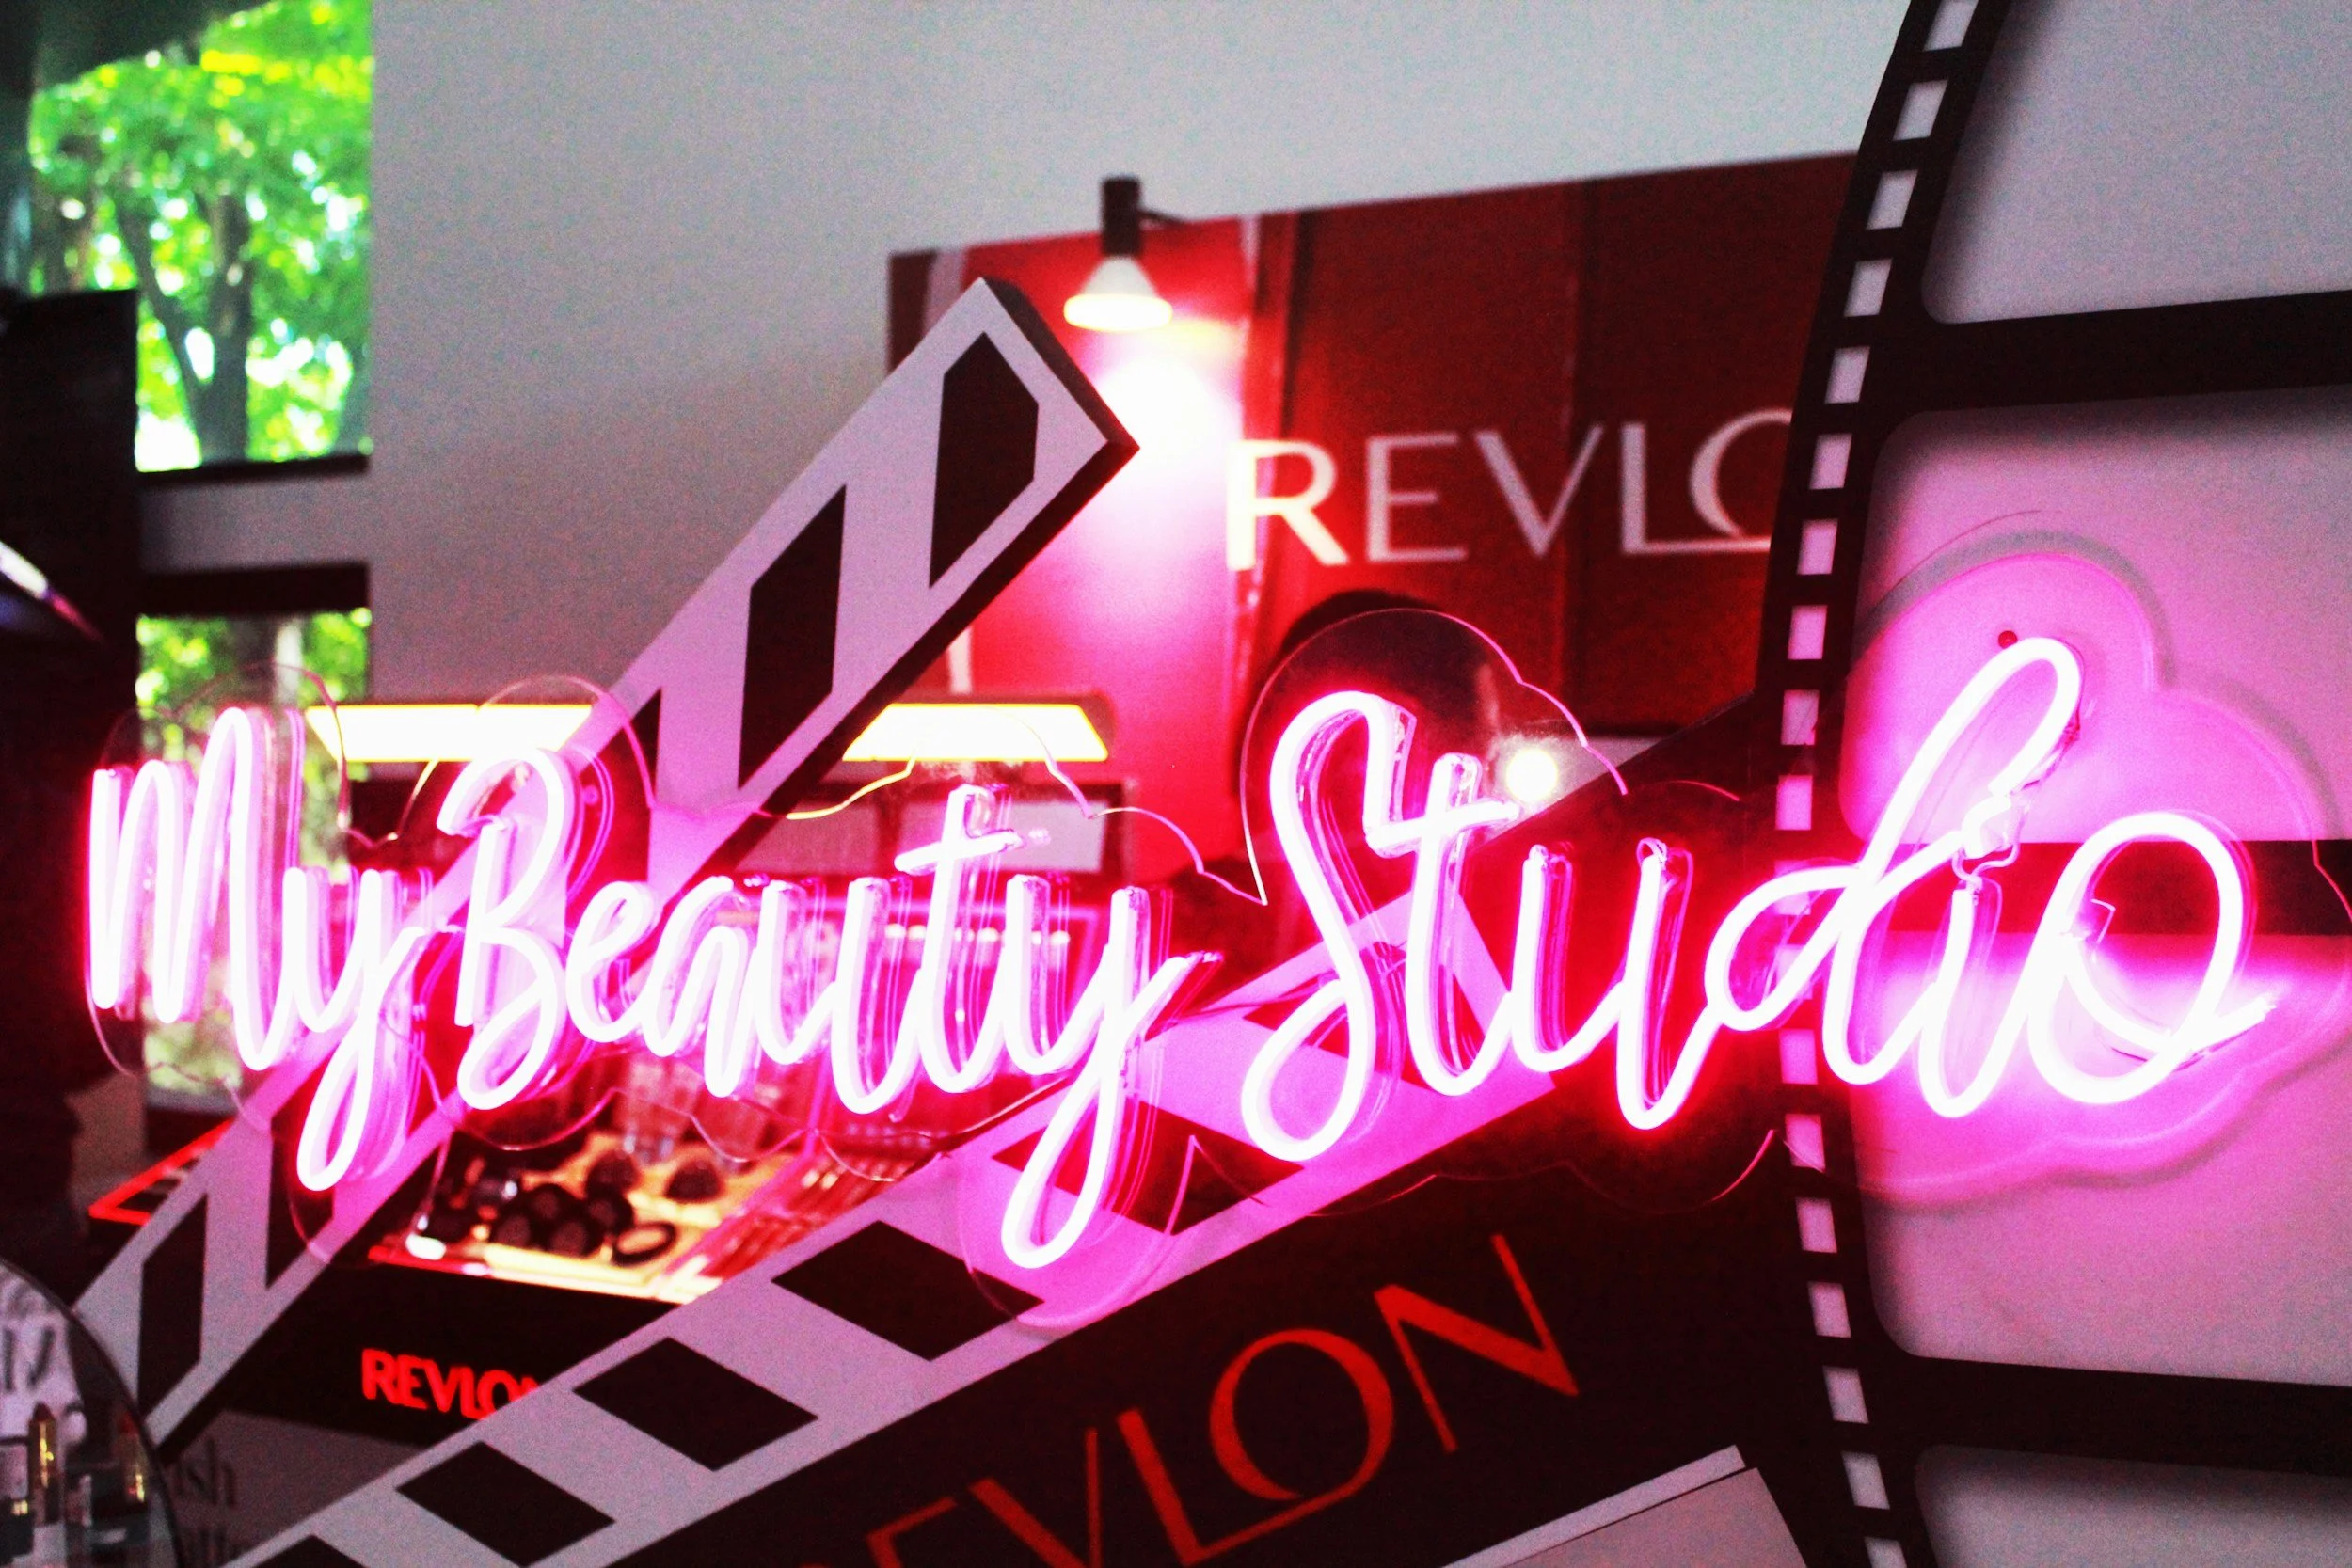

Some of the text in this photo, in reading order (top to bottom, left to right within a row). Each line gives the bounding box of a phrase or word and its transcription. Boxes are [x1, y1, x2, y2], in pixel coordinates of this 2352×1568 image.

[1225, 408, 1791, 571] REVLO
[88, 638, 2273, 1269] My Beauty Studio
[362, 1348, 540, 1420] REVLO
